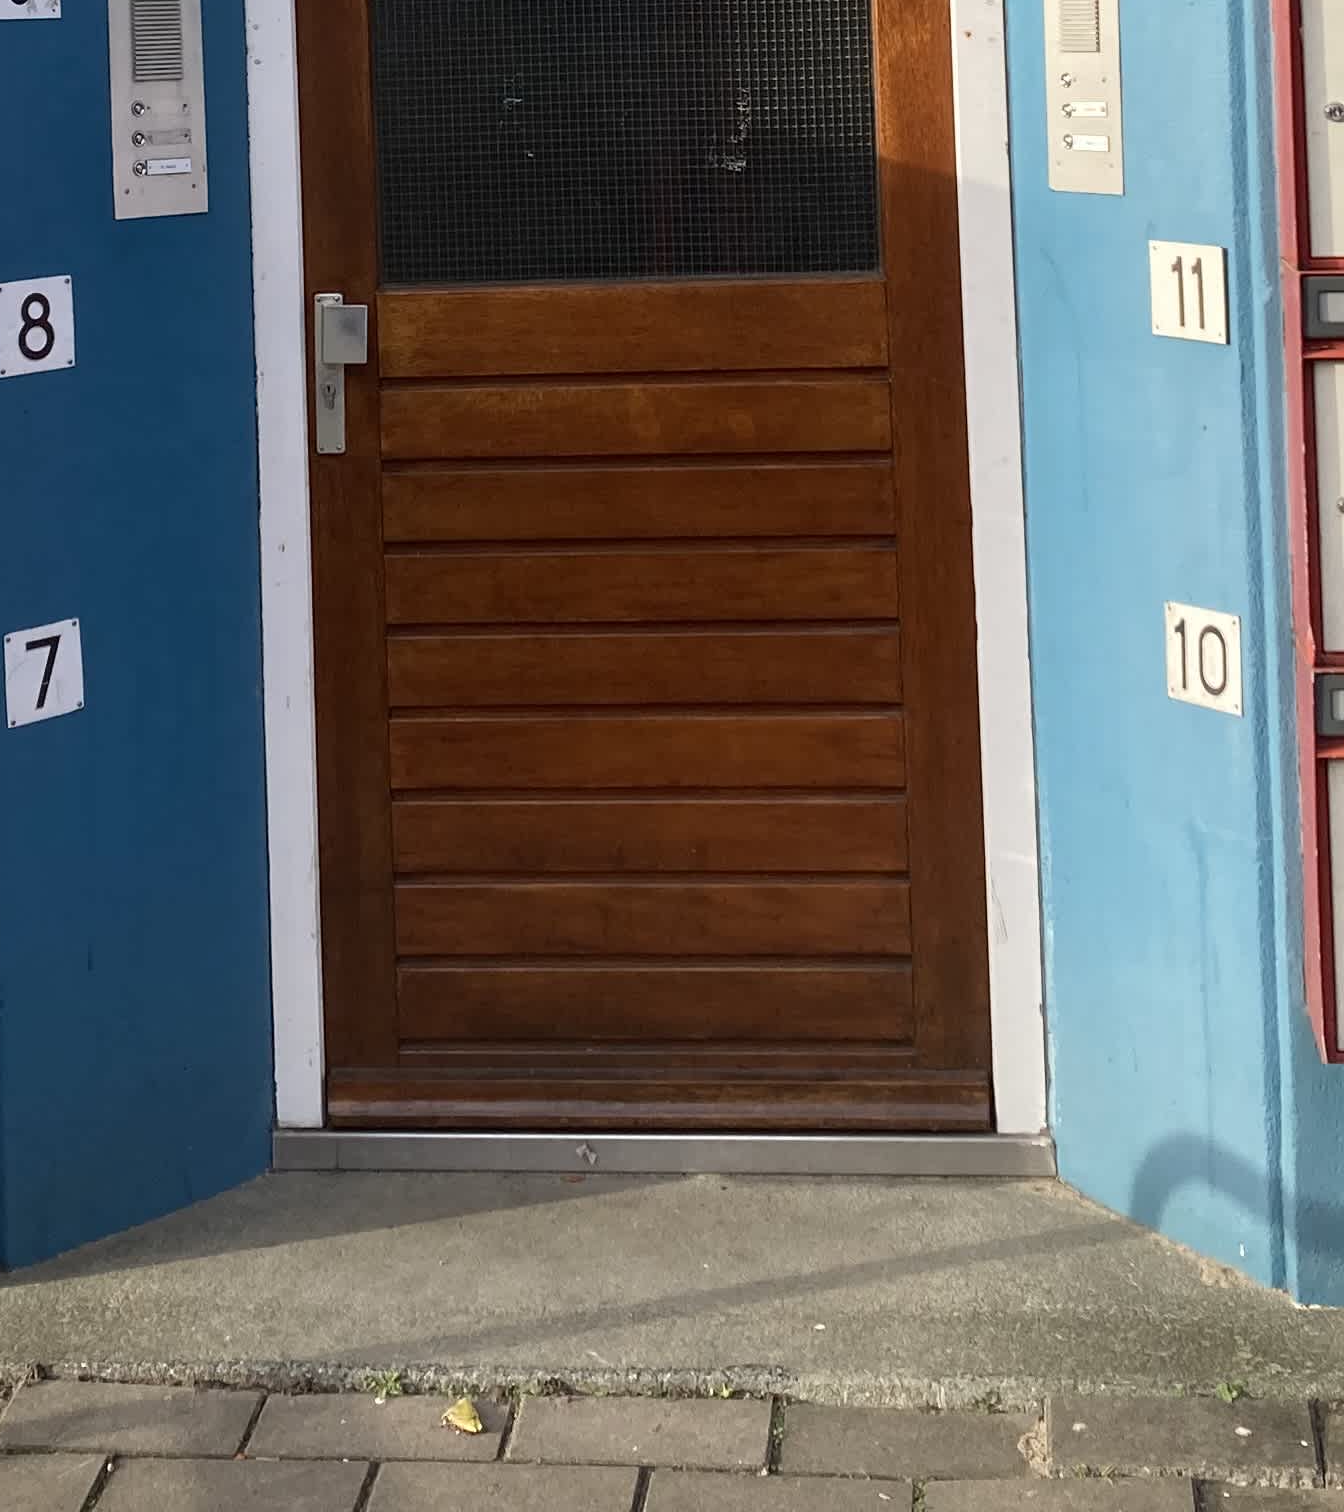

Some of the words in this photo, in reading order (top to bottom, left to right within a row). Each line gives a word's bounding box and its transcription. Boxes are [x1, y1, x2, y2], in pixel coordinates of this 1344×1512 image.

[18, 292, 54, 360] 8
[1171, 256, 1207, 330] 11
[25, 634, 61, 709] 7
[1174, 618, 1228, 696] 10
